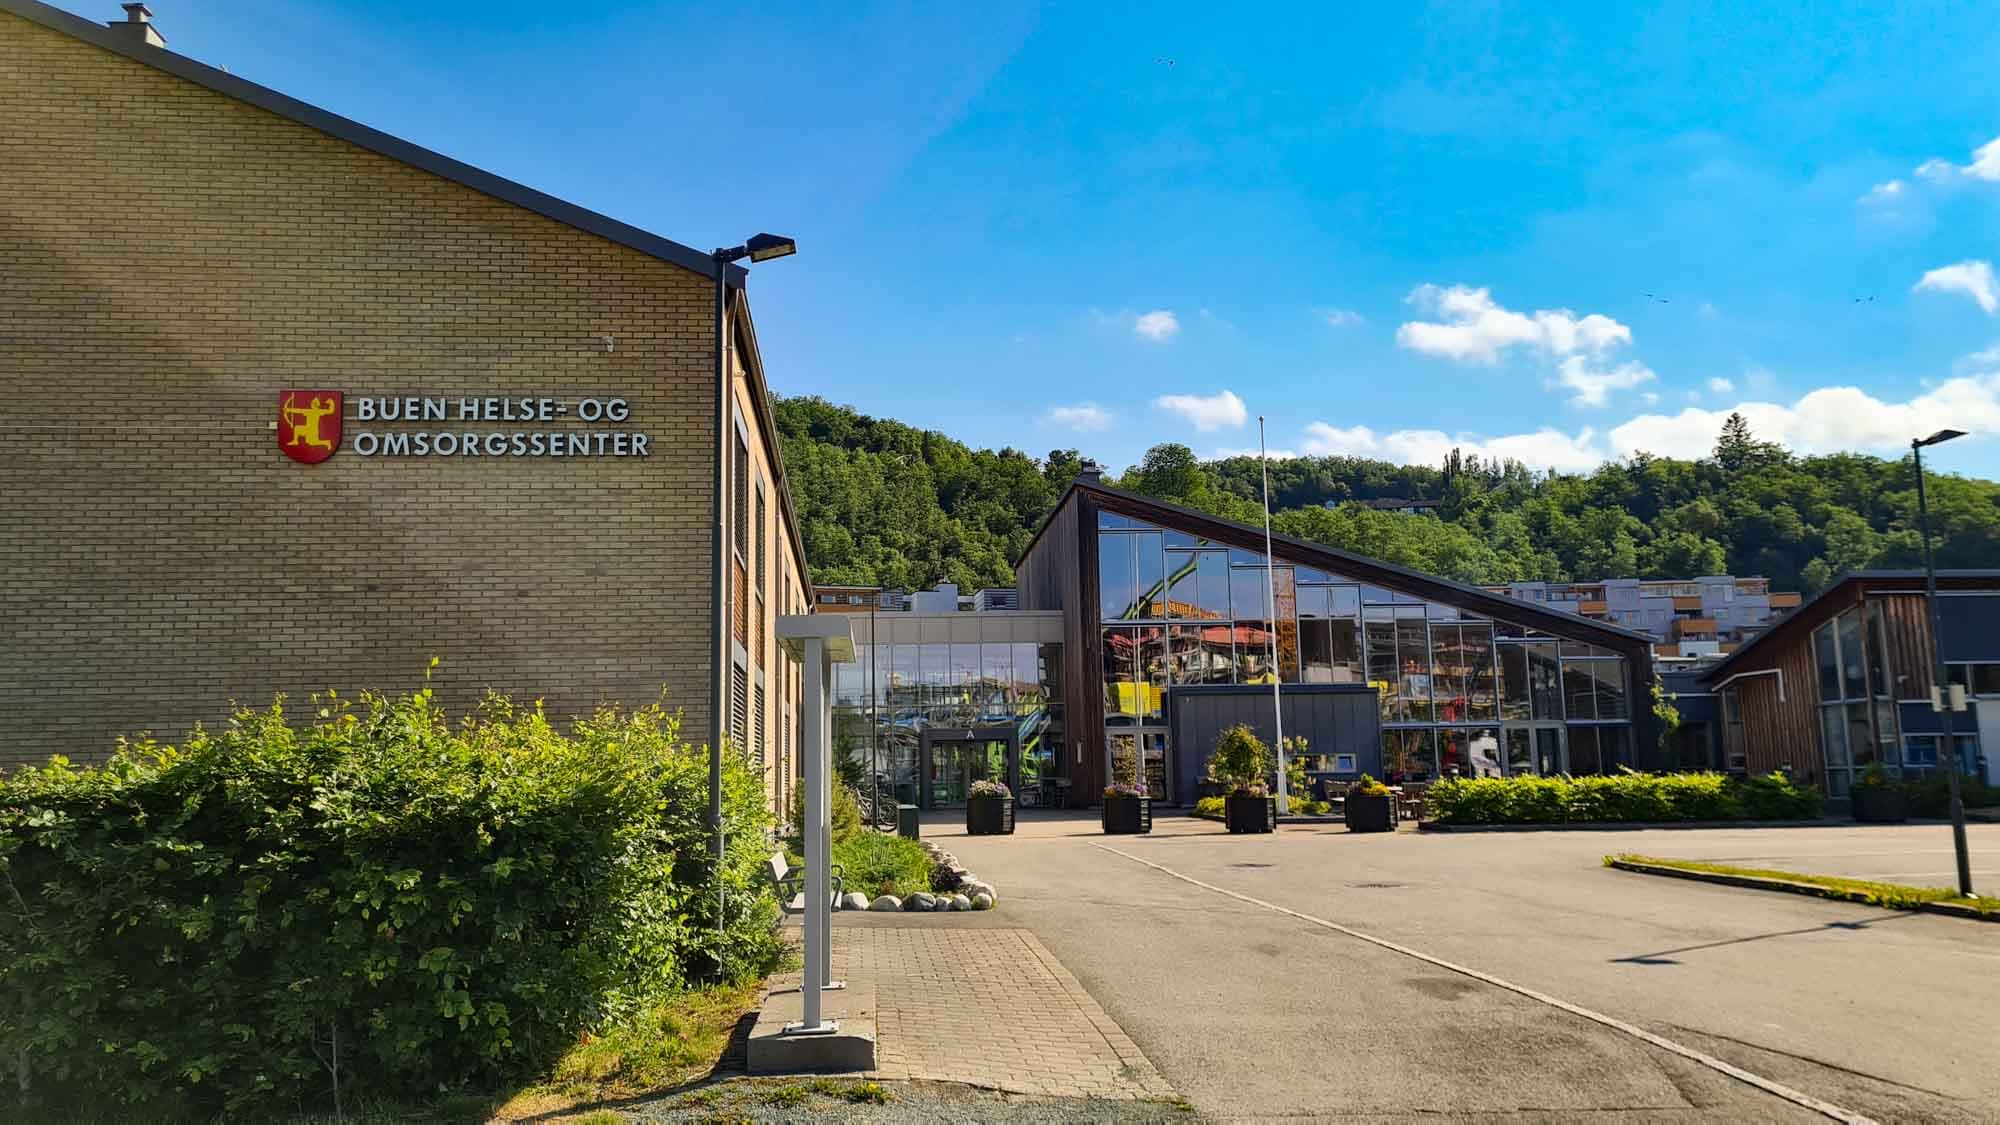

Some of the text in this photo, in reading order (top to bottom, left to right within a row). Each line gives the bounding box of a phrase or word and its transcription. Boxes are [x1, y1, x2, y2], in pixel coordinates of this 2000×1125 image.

[357, 397, 630, 422] BUEN HELSE- OG
[353, 432, 649, 457] OMSORGSSENTER
[965, 729, 975, 739] A
